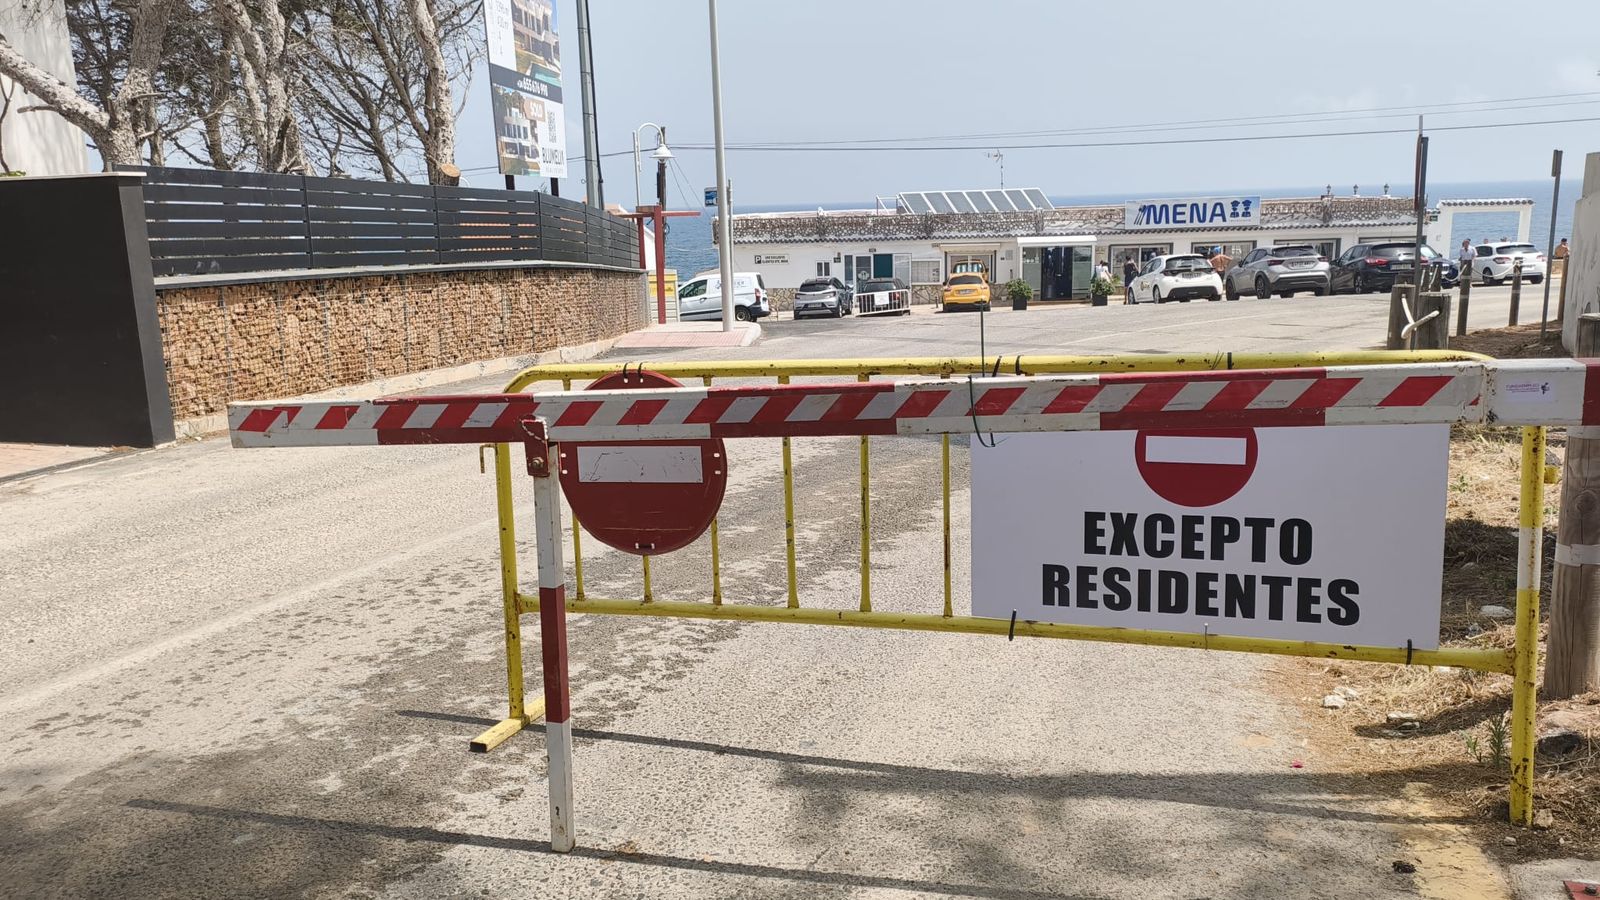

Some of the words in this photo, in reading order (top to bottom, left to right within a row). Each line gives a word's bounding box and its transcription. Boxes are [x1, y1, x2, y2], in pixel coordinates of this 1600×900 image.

[1145, 202, 1227, 225] MENA
[1083, 511, 1313, 566] EXCEPTO
[1042, 563, 1360, 627] RESIDENTES
